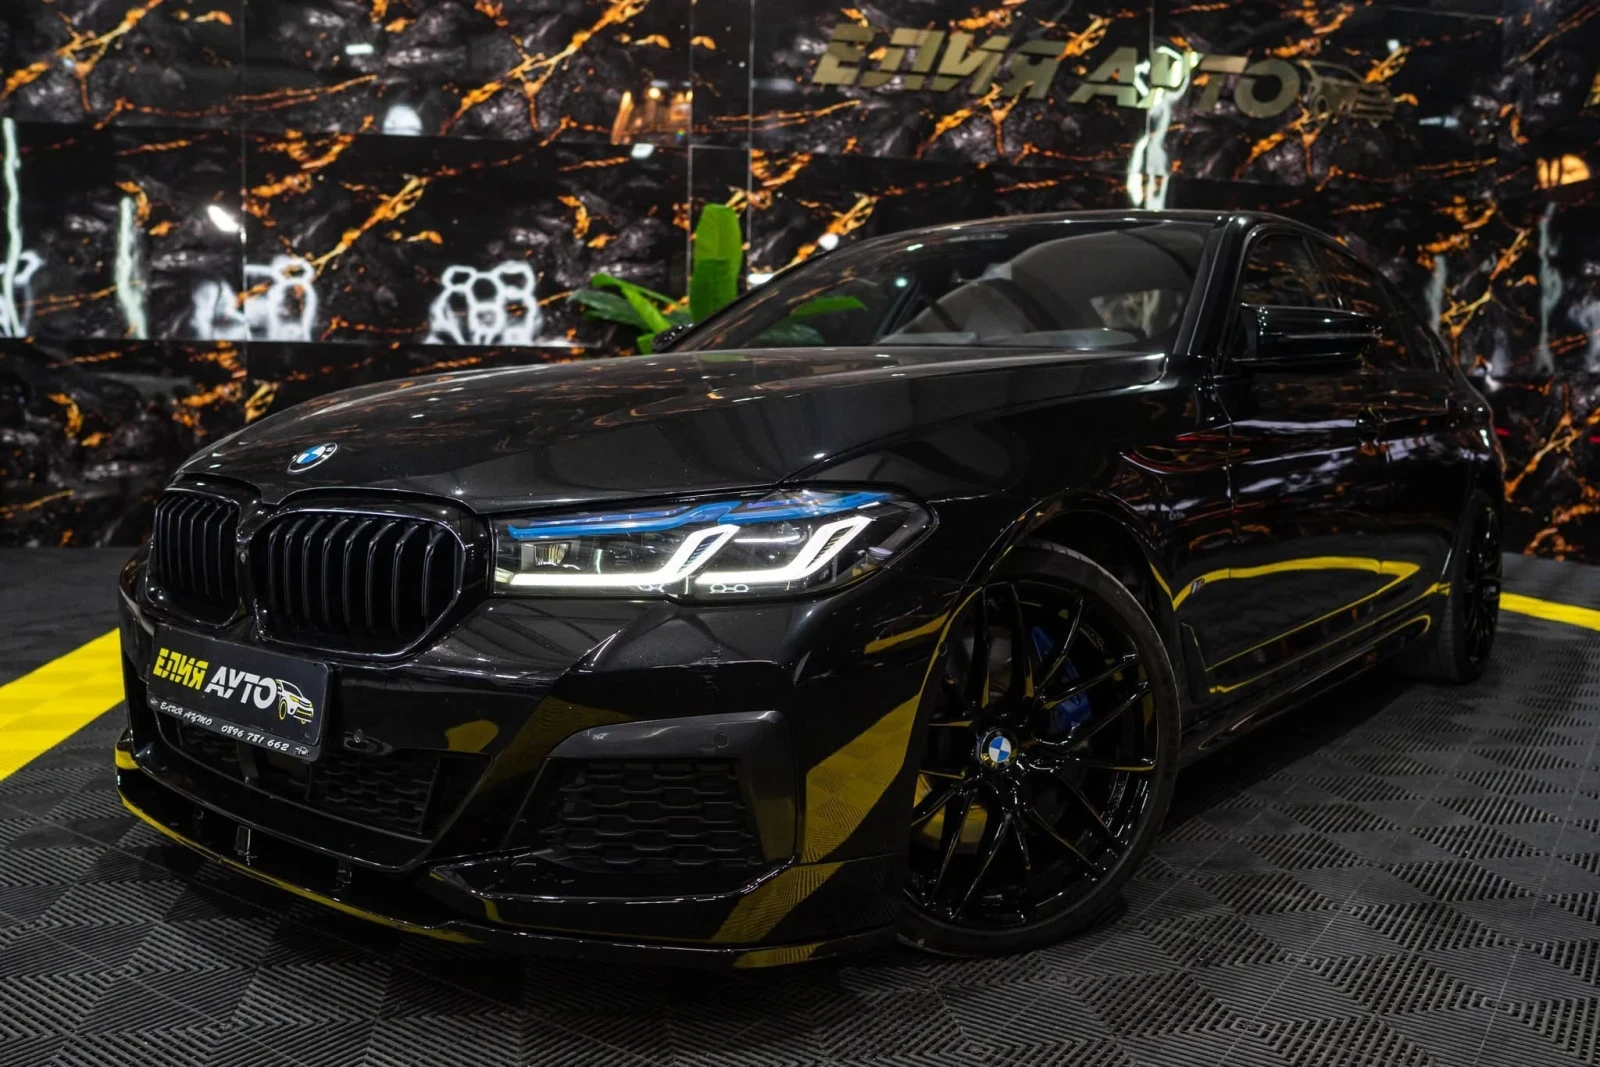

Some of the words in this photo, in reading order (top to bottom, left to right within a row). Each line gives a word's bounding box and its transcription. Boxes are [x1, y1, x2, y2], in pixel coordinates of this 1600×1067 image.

[1070, 46, 1301, 119] АУТО
[153, 648, 208, 690] ЕЛИЯ
[205, 666, 277, 709] АУТО
[221, 725, 244, 738] 0896
[247, 732, 264, 744] 781
[268, 739, 290, 751] 662
